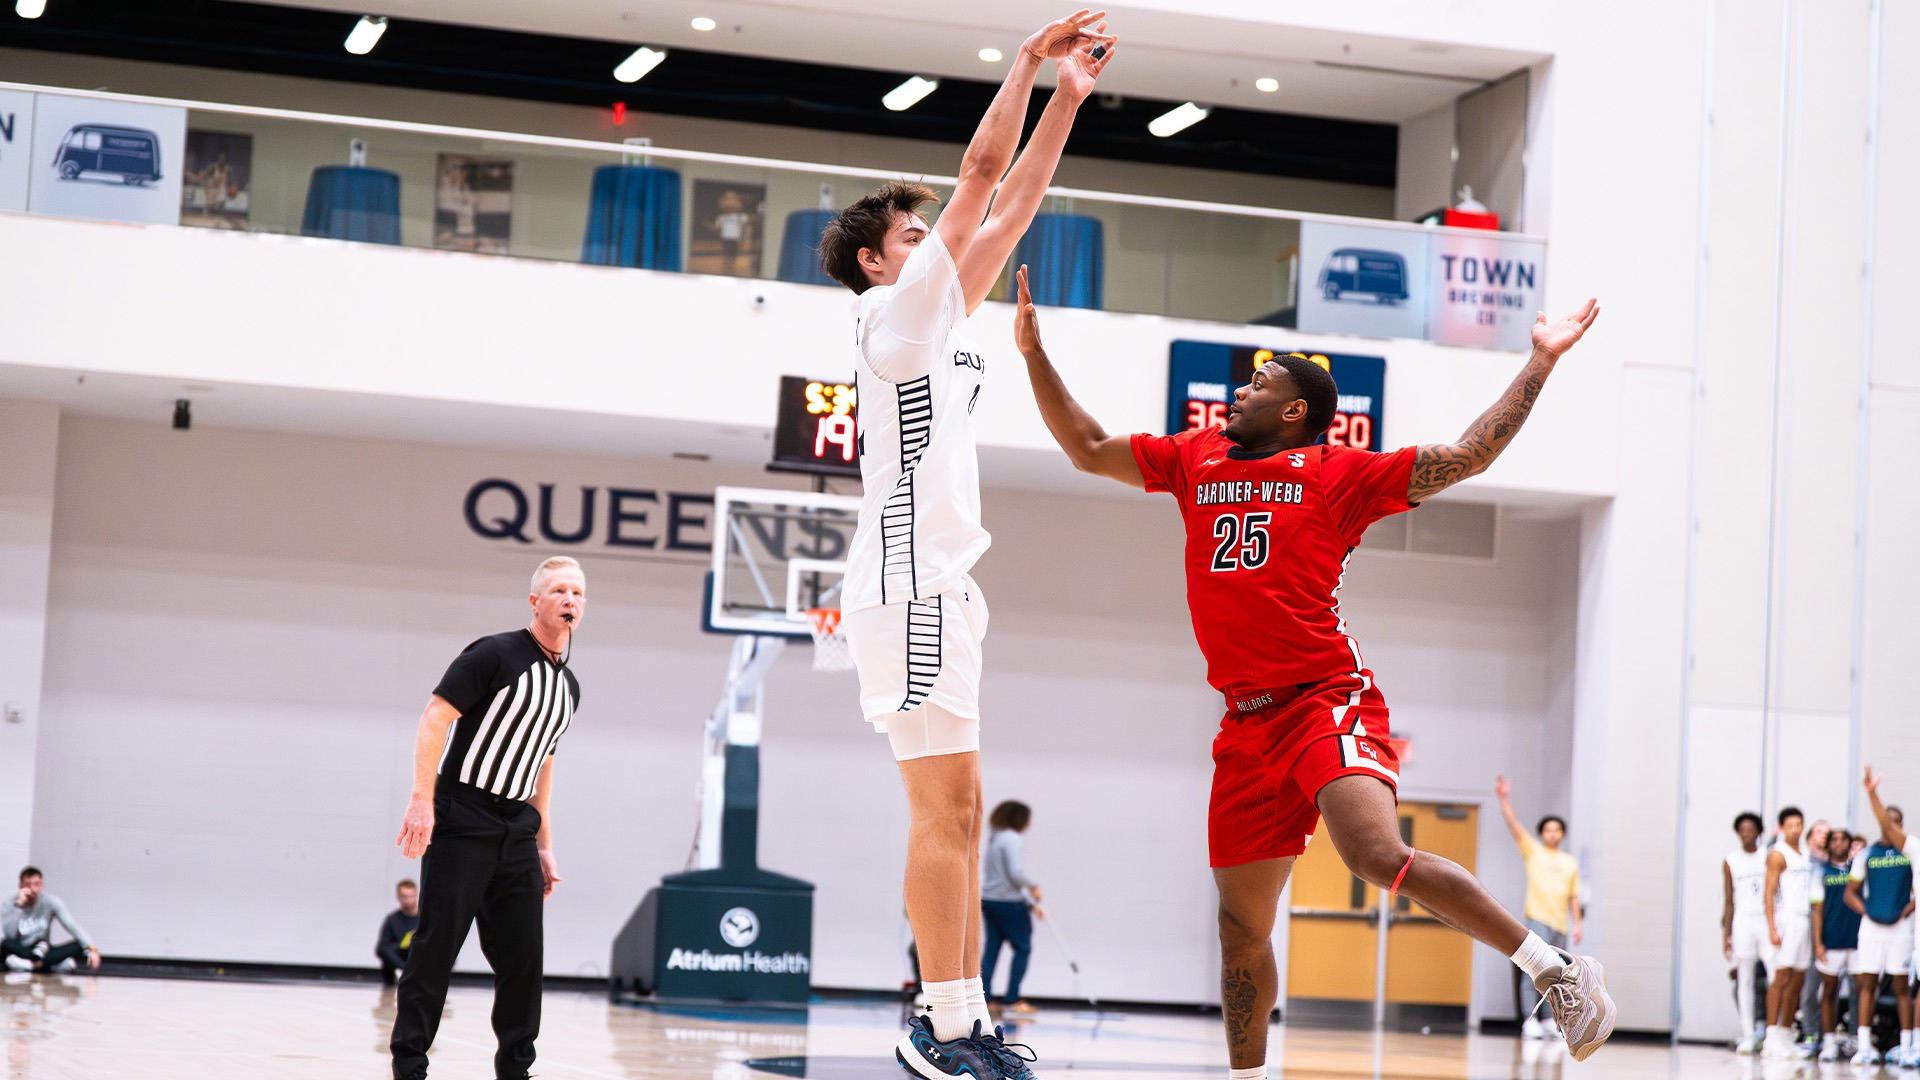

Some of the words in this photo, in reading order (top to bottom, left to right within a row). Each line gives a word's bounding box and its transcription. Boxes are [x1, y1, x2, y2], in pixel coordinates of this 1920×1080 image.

[1440, 254, 1537, 288] TOWN
[1448, 289, 1525, 309] BREWING
[953, 350, 985, 374] QU
[1187, 382, 1228, 401] HOME
[1337, 395, 1372, 414] UEST
[1187, 401, 1231, 432] 36
[814, 414, 855, 461] 19
[1327, 413, 1371, 449] 20
[1196, 481, 1303, 506] GARDNER-WEBB
[463, 477, 846, 562] QUEENS
[1210, 511, 1273, 573] 25
[1236, 693, 1274, 712] BULLDOGS
[667, 948, 742, 971] Atrium
[743, 950, 810, 974] Health
